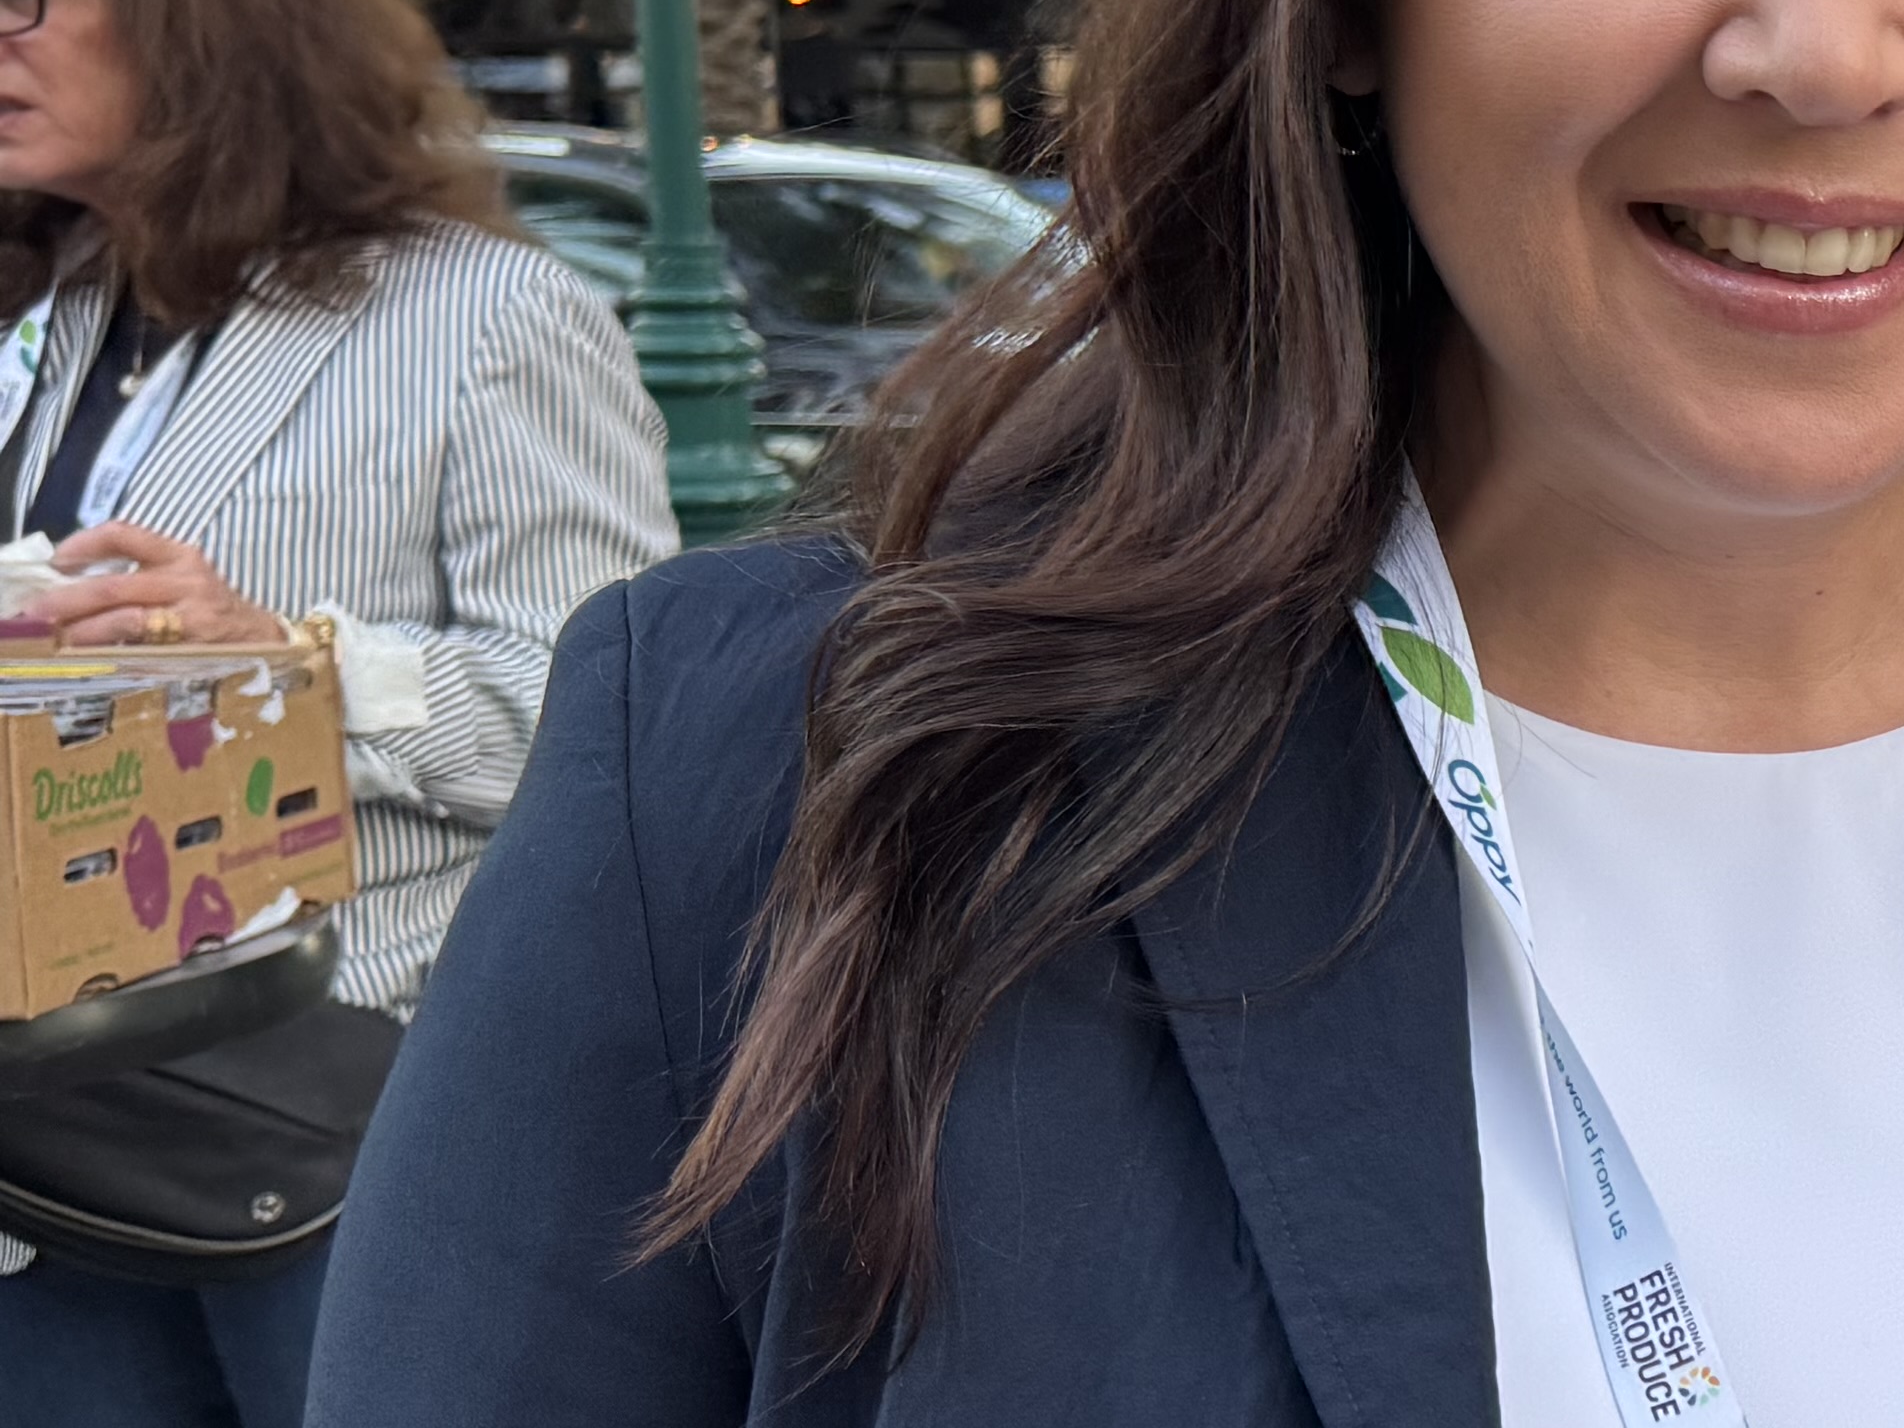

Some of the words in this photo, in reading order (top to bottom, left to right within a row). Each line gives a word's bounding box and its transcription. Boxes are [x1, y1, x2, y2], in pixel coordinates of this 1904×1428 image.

[1447, 758, 1522, 906] Oppy
[1564, 1075, 1599, 1145] world
[1589, 1147, 1618, 1209] from
[1609, 1210, 1629, 1242] us
[1600, 1293, 1630, 1370] ASSOCIATION
[1613, 1282, 1681, 1423] PRODUCE
[1638, 1269, 1696, 1371] FRESH
[1664, 1262, 1706, 1355] INTERNATIONAL
